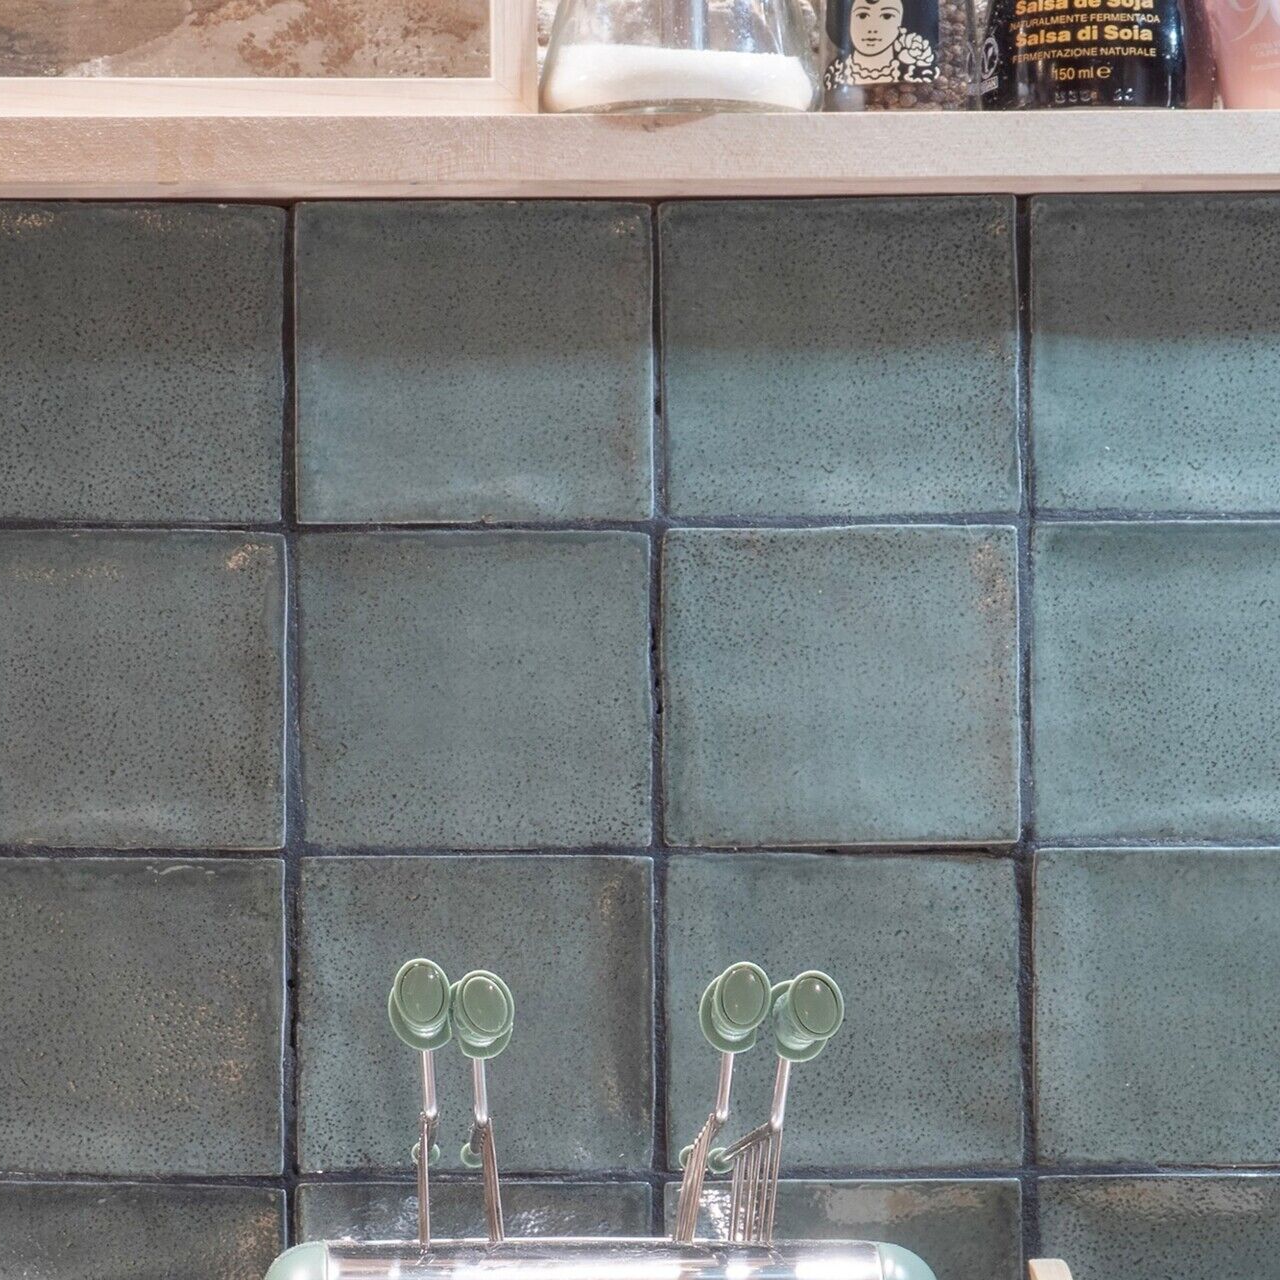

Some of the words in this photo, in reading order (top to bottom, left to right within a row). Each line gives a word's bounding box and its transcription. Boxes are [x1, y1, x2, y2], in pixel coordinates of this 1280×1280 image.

[1009, 14, 1088, 32] NATURALMENTE
[1090, 13, 1161, 24] FERMENTADA
[1015, 29, 1071, 48] Salsa
[1077, 25, 1099, 41] di
[1104, 25, 1154, 41] Soia
[1012, 47, 1099, 64] FERMENTAZIONE
[1099, 47, 1158, 58] NATURALE
